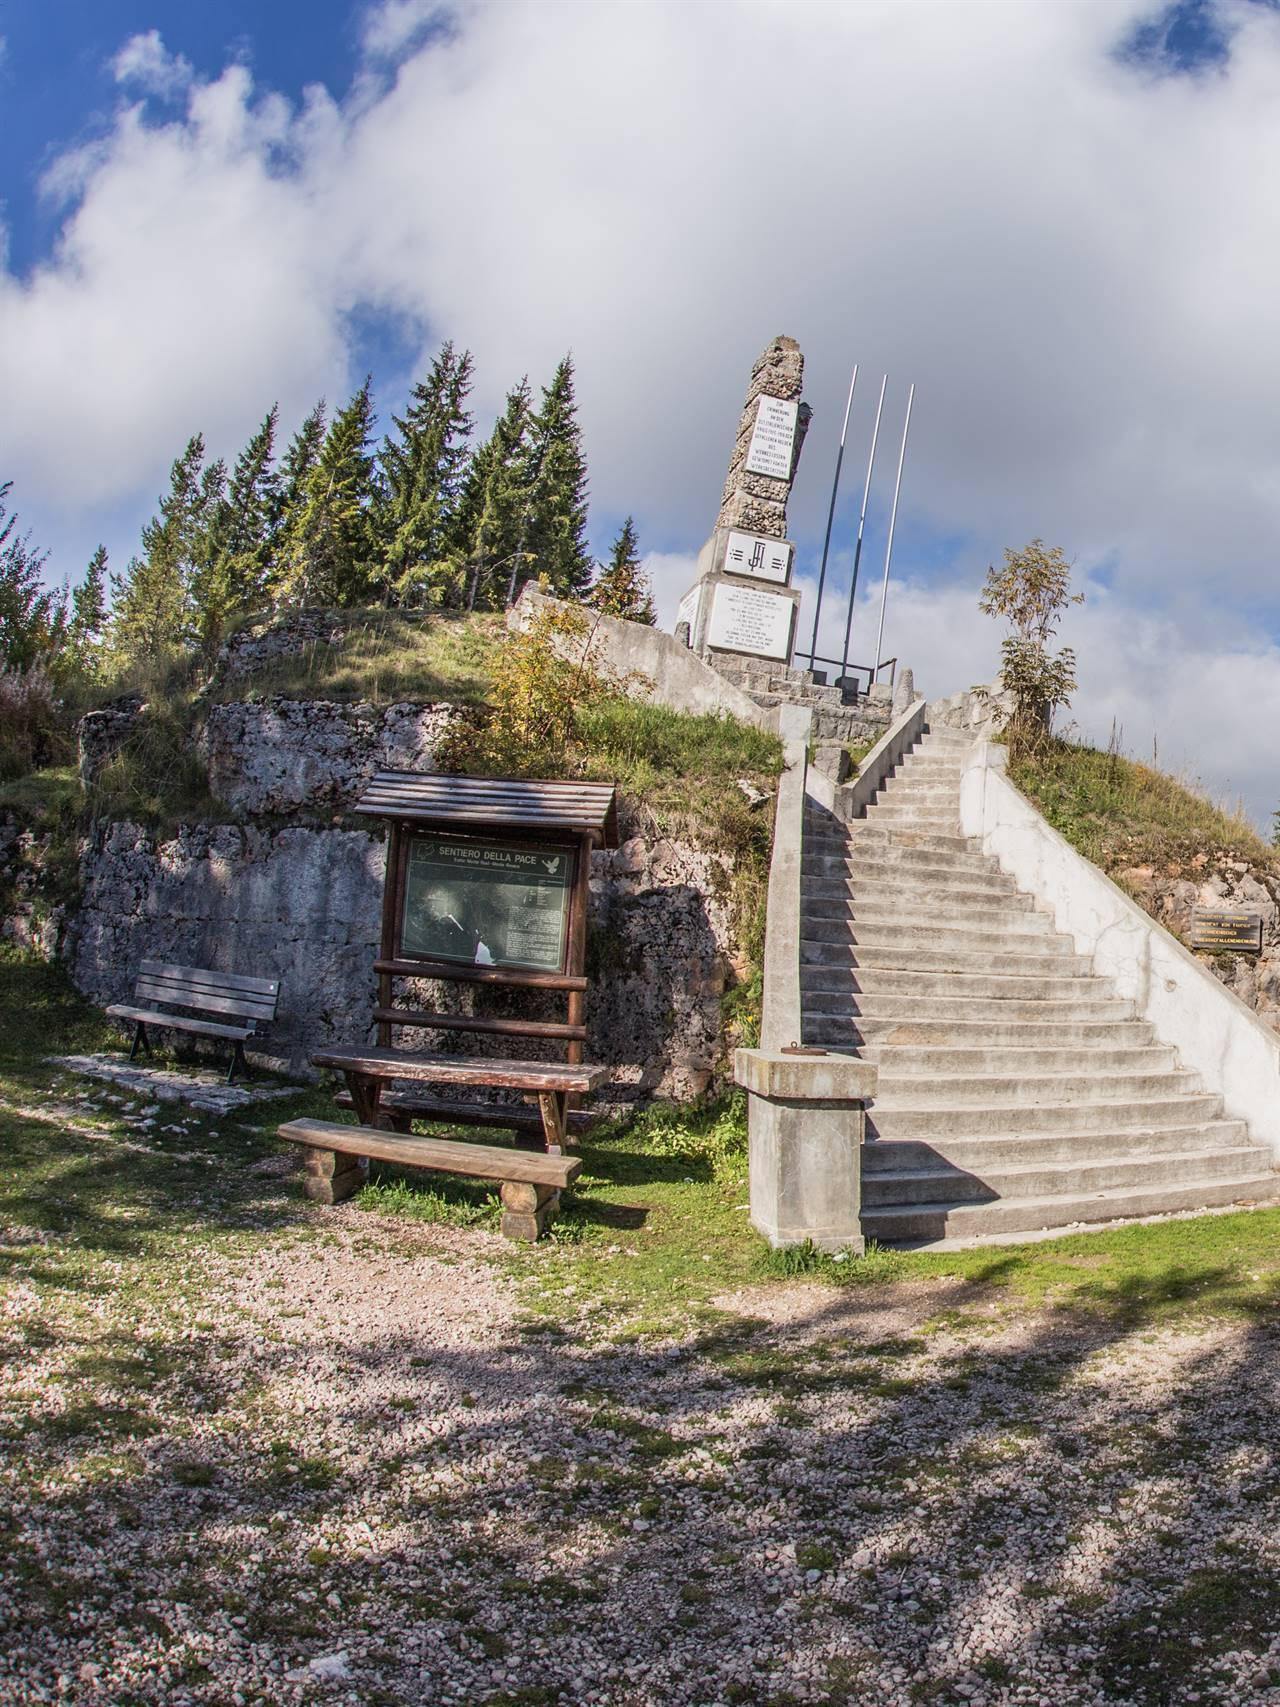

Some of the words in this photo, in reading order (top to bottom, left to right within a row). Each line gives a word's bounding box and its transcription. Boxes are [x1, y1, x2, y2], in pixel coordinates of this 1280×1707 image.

[439, 846, 481, 858] SENTIERO
[484, 850, 512, 862] DELLA
[514, 854, 537, 865] PACE
